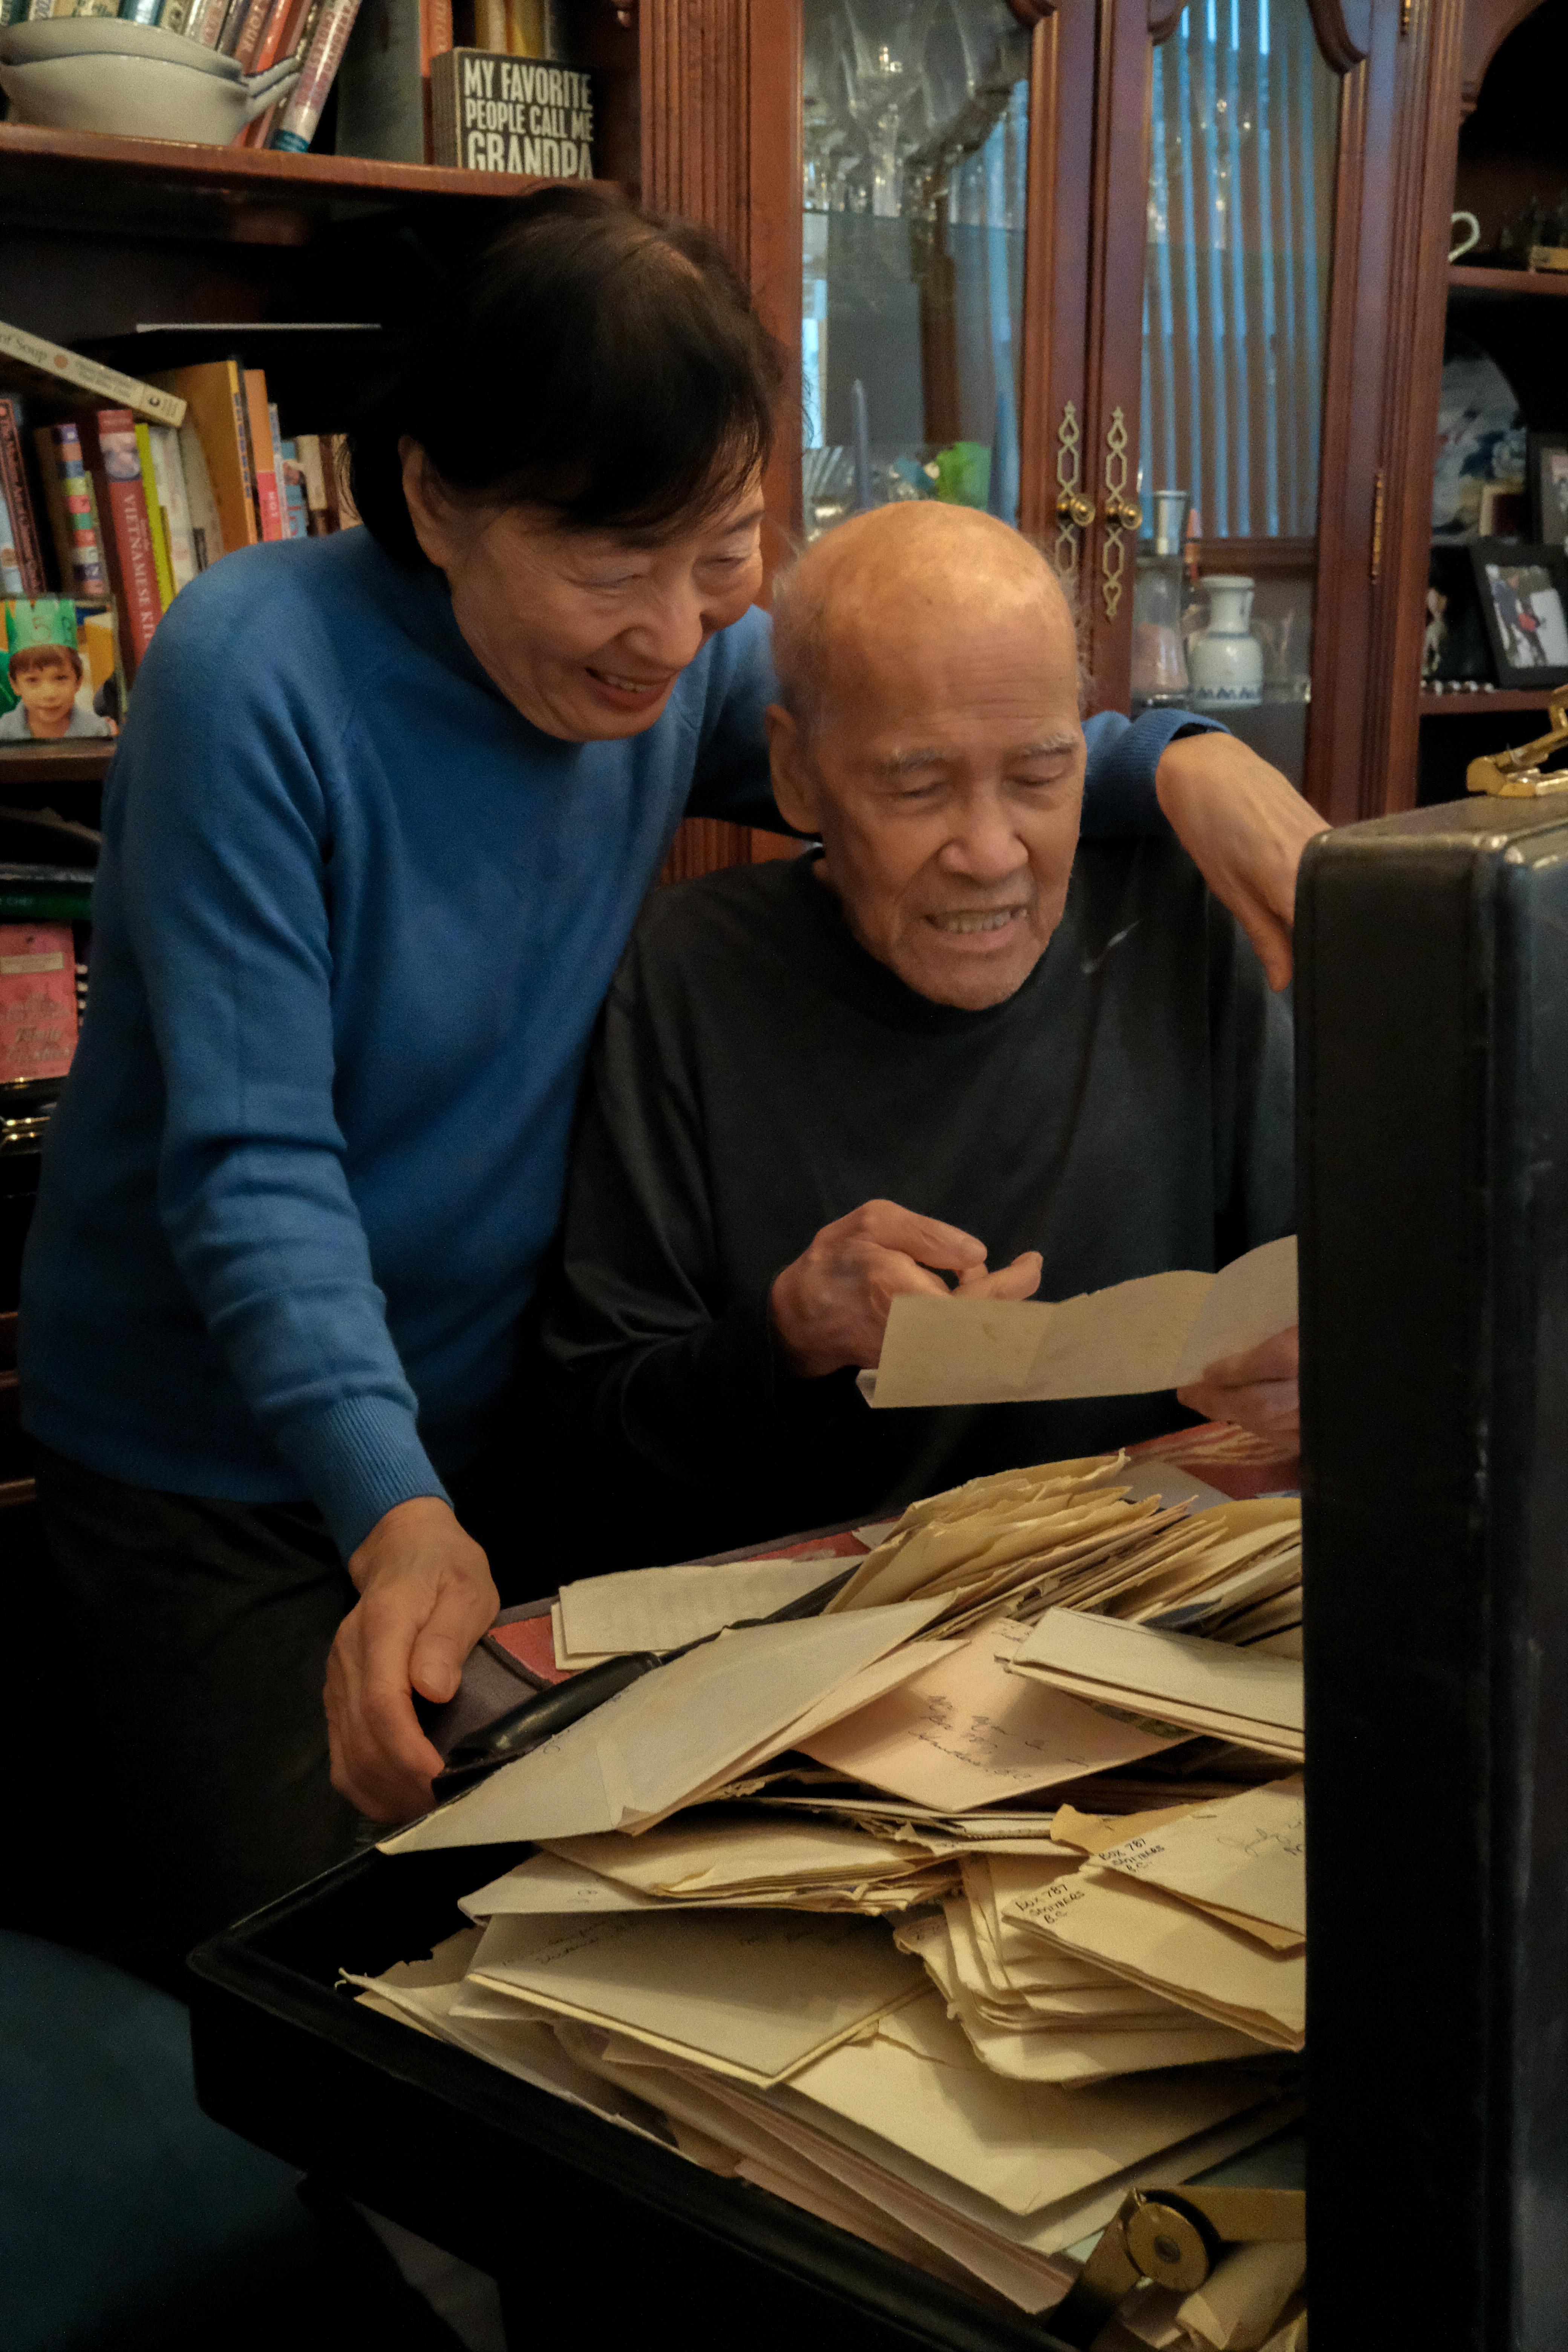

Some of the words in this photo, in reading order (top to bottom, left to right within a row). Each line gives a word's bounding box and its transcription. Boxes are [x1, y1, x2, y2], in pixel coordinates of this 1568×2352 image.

[464, 58, 495, 99] MY
[501, 63, 593, 110] FAVORITE
[465, 98, 526, 135] PEOPLE
[529, 105, 568, 138] CALL
[571, 110, 594, 142] ME
[467, 130, 594, 181] GRANDPA
[124, 494, 151, 607] VIETNAMESE
[1041, 1883, 1067, 1898] 787
